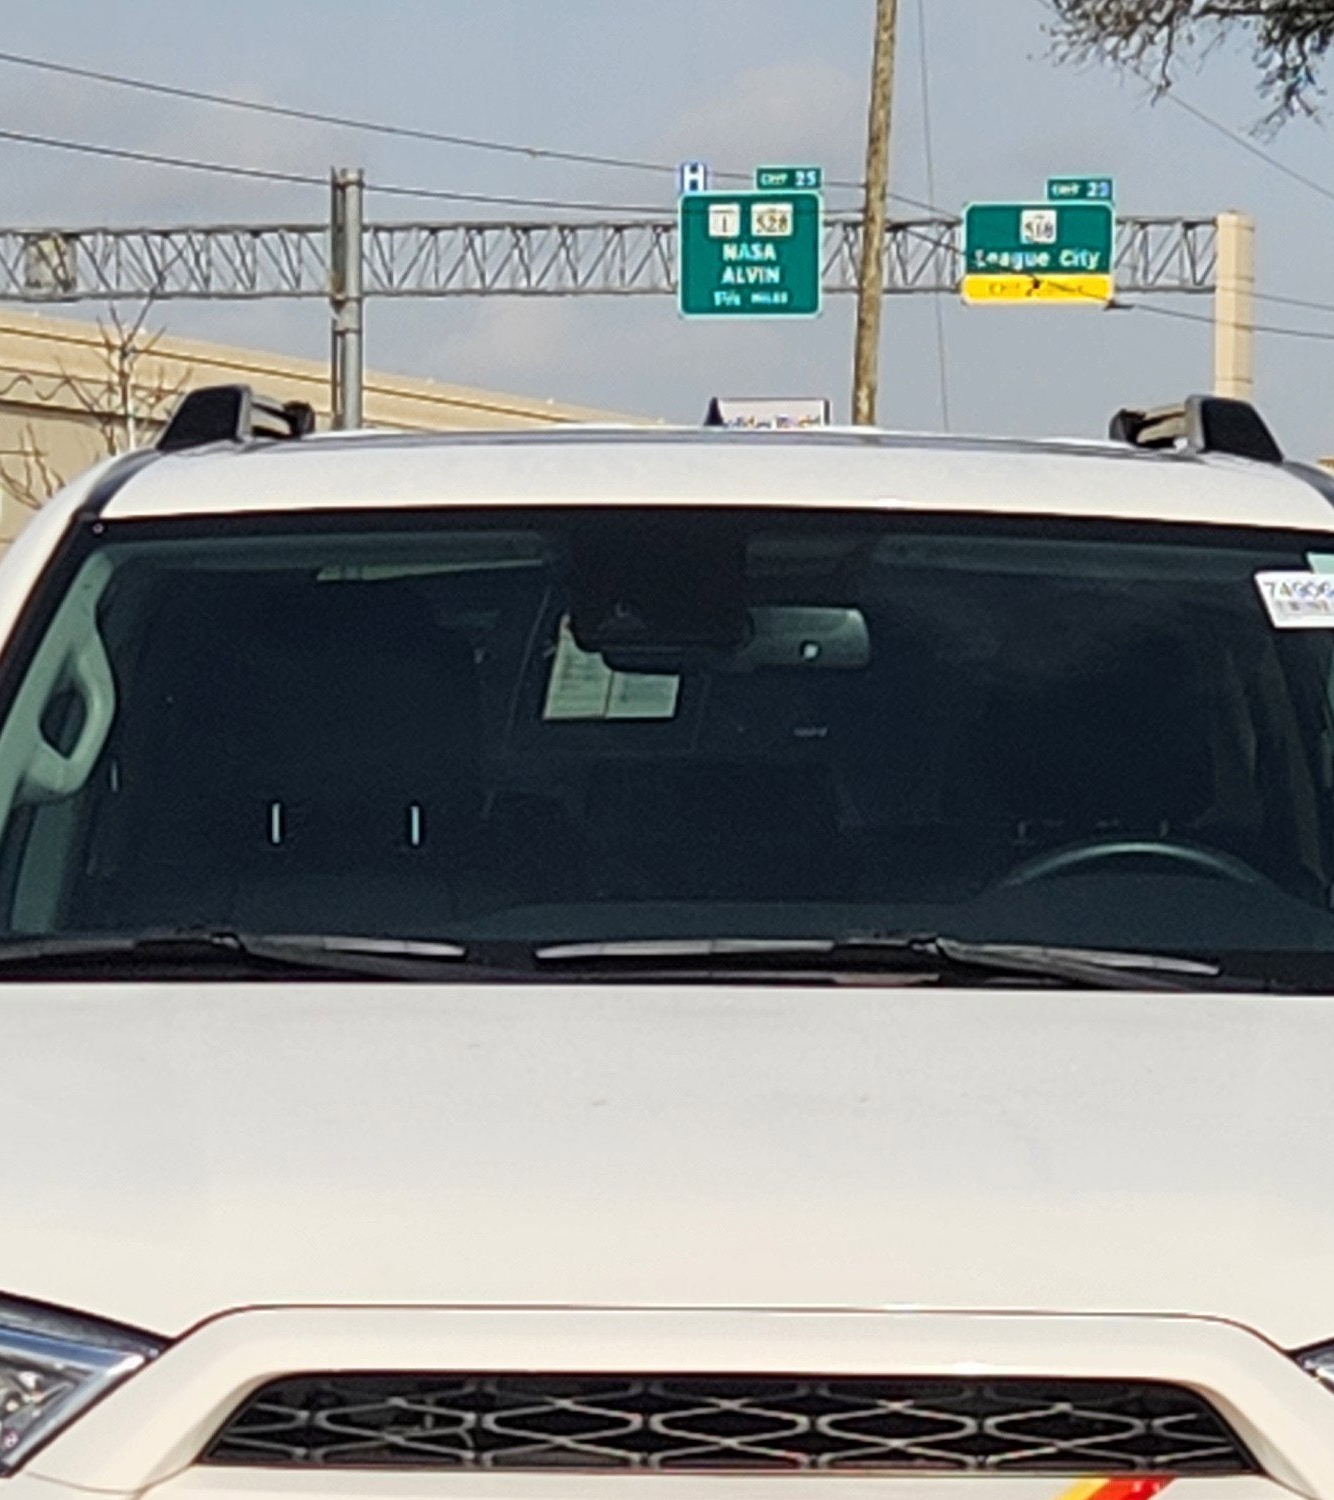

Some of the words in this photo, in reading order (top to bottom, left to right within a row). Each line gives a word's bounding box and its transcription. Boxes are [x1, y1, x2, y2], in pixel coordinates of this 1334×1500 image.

[722, 242, 777, 261] NASA
[974, 249, 1050, 270] League
[1059, 248, 1101, 270] City
[720, 266, 780, 284] ALVIN
